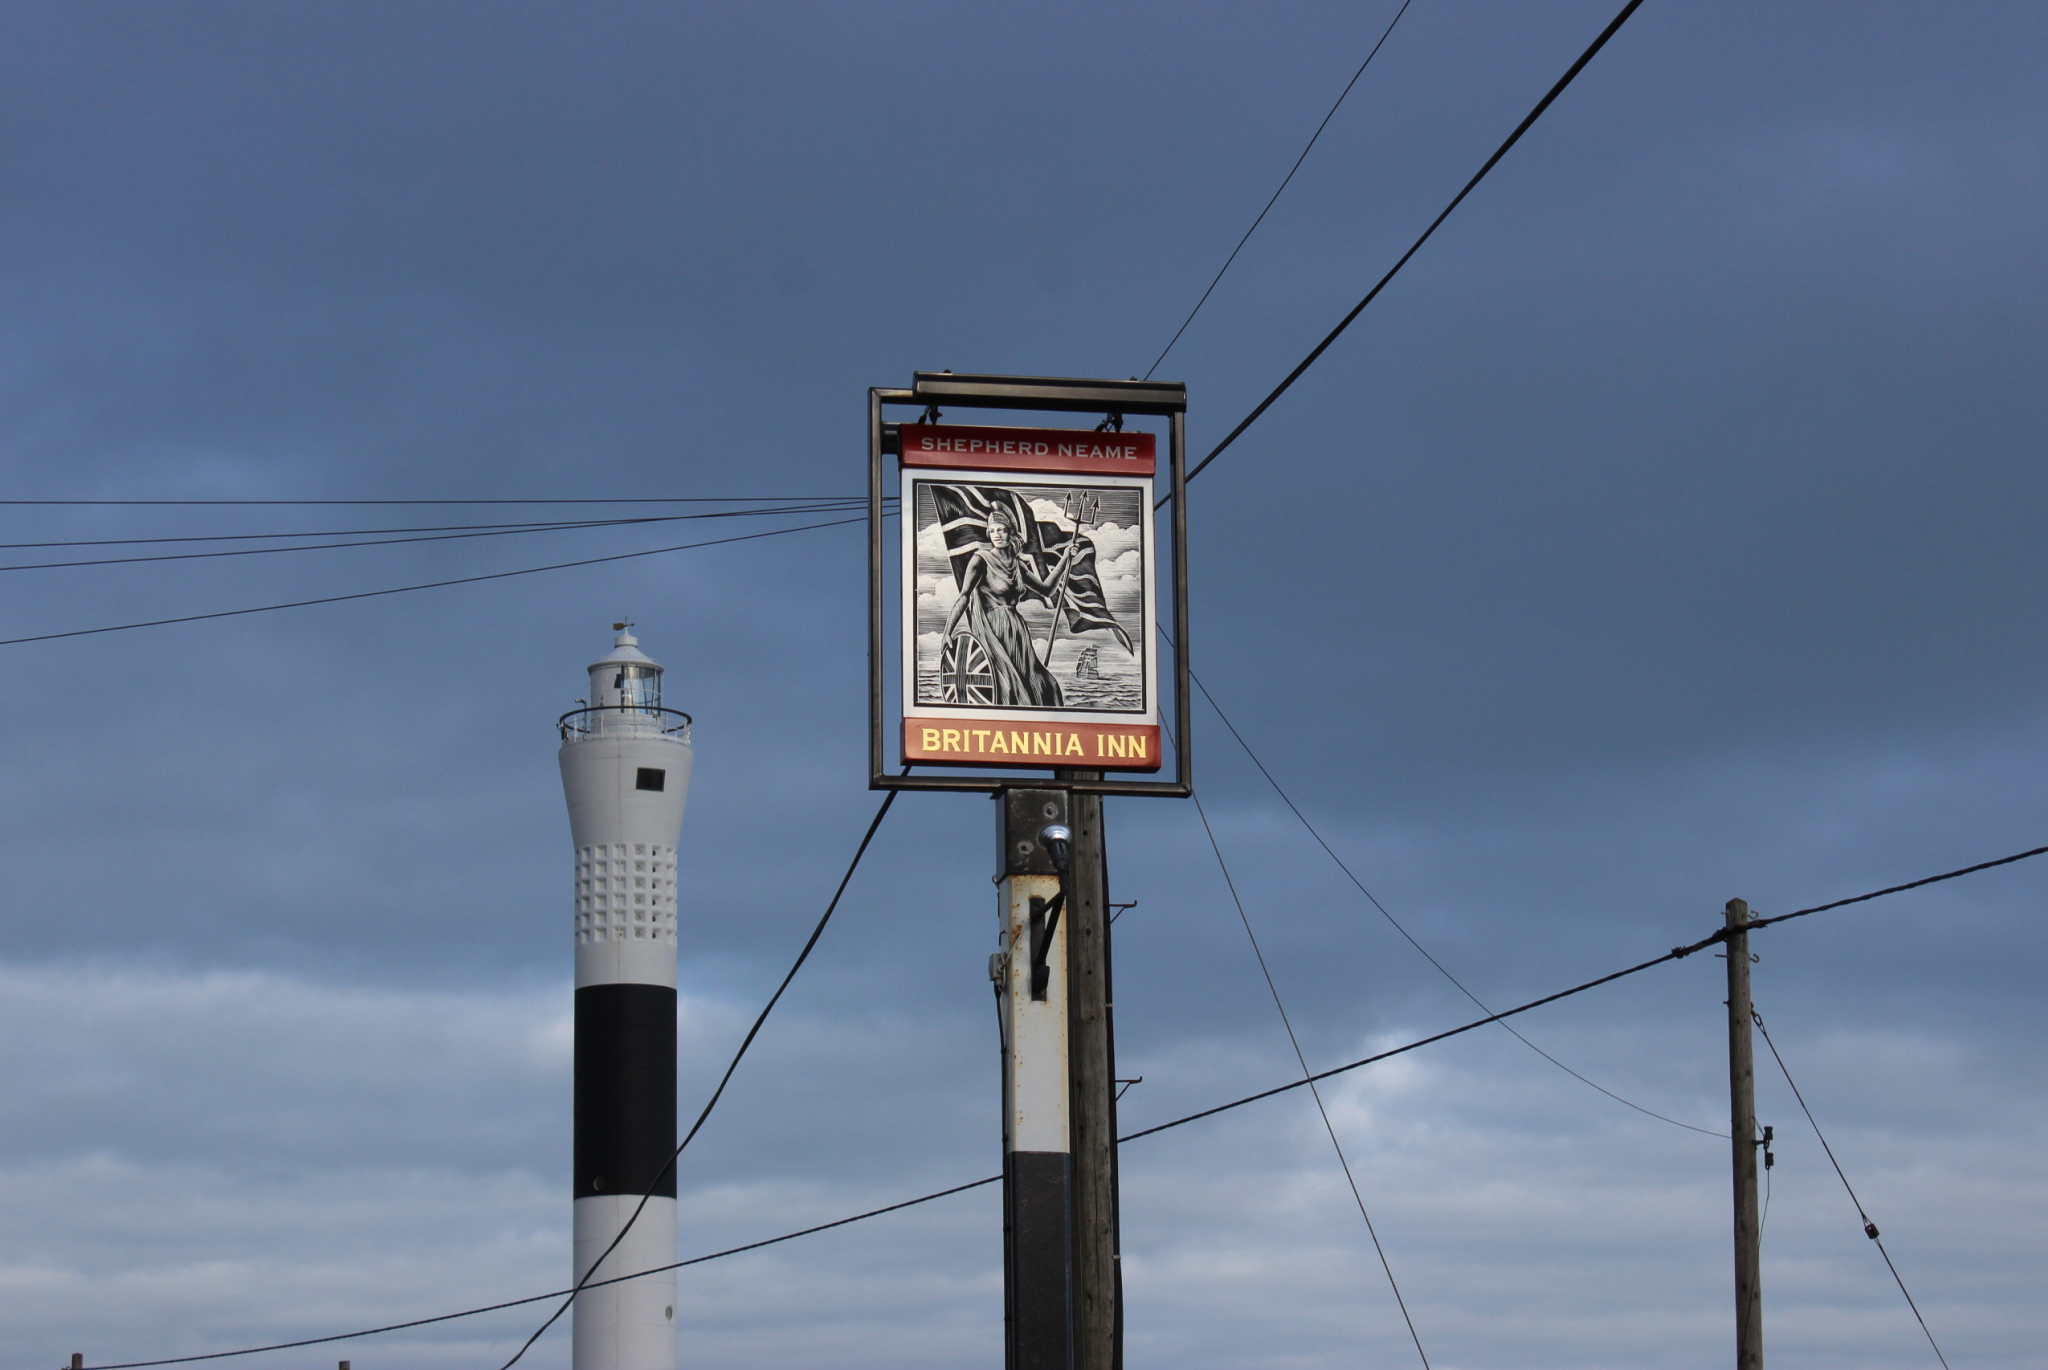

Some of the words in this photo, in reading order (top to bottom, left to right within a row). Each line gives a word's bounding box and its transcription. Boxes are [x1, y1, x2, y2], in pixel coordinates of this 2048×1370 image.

[921, 437, 1049, 456] SHEPHERD
[1058, 443, 1138, 460] NEAME
[922, 728, 1085, 756] BRITANNIA
[1097, 734, 1147, 758] INN
